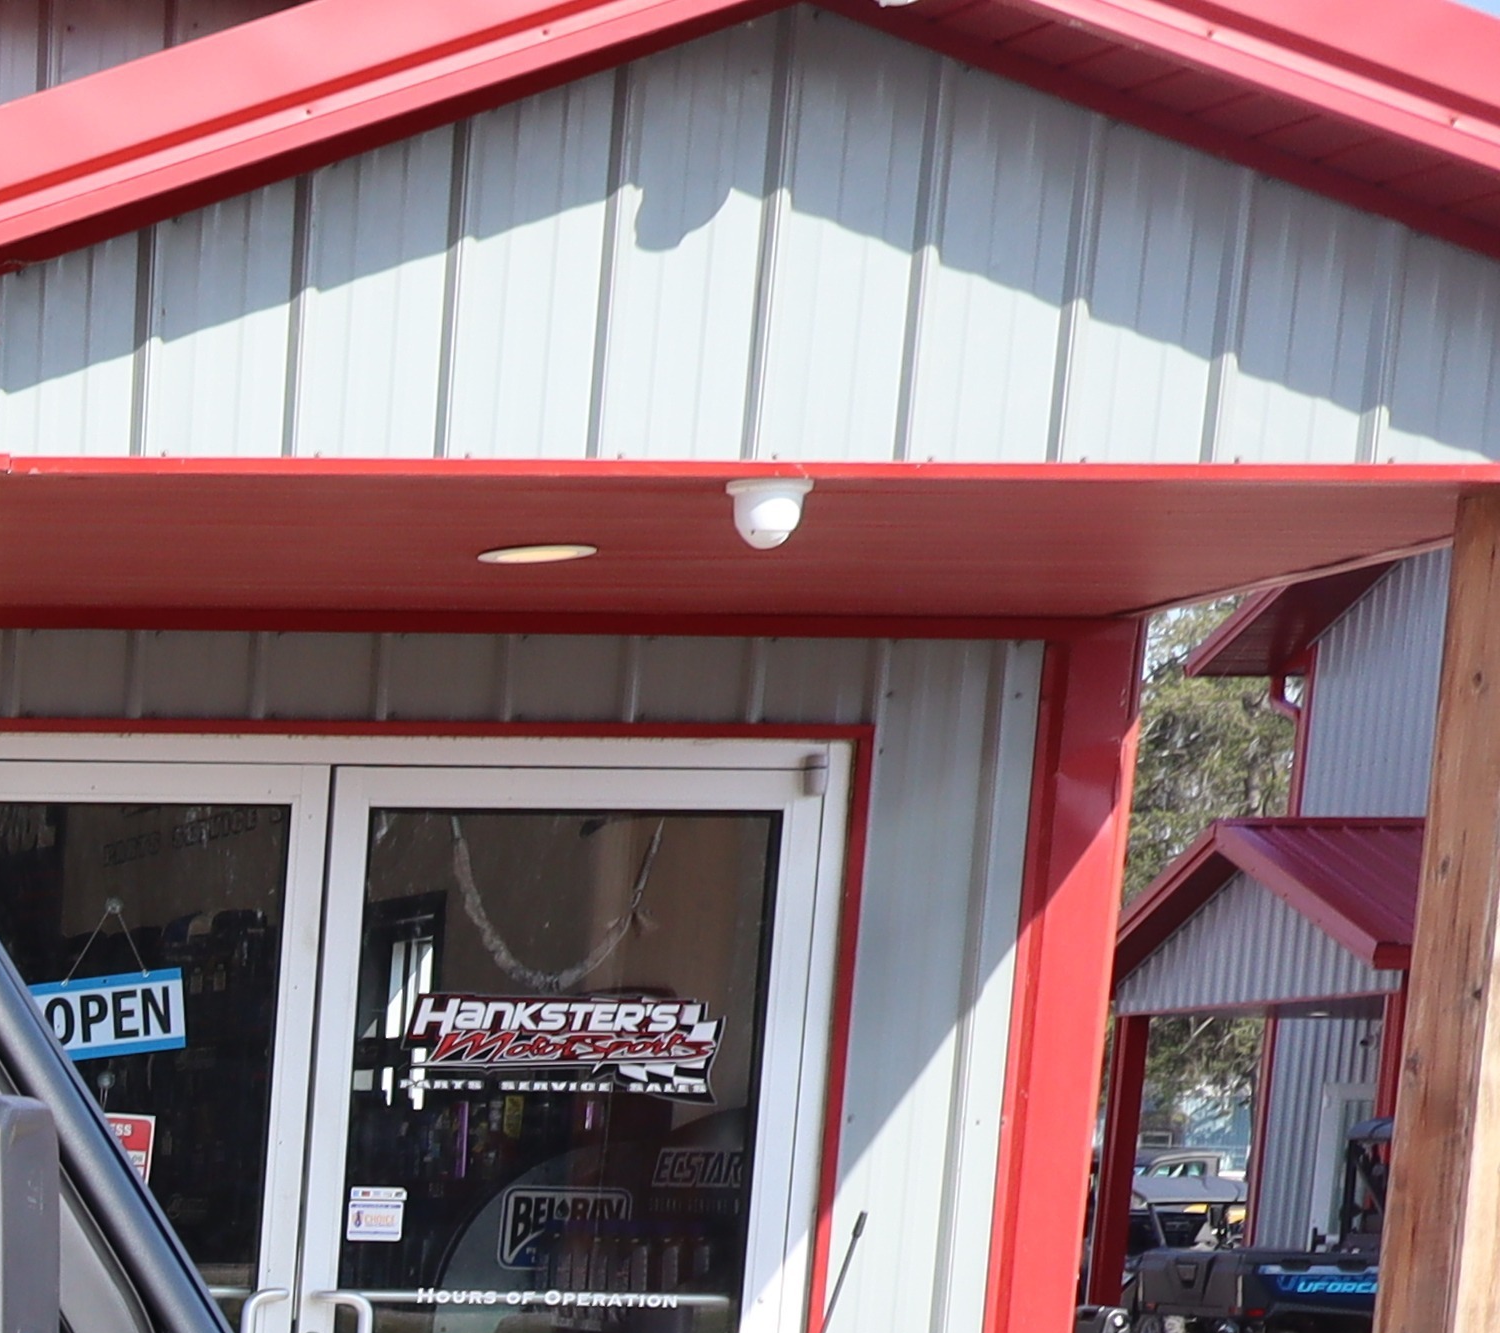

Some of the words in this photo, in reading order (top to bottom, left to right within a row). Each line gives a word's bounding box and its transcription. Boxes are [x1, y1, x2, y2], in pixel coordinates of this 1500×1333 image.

[44, 985, 172, 1046] OPEN
[400, 1079, 483, 1091] PARTS
[500, 1080, 612, 1093] SERVICE
[629, 1081, 708, 1094] SALES
